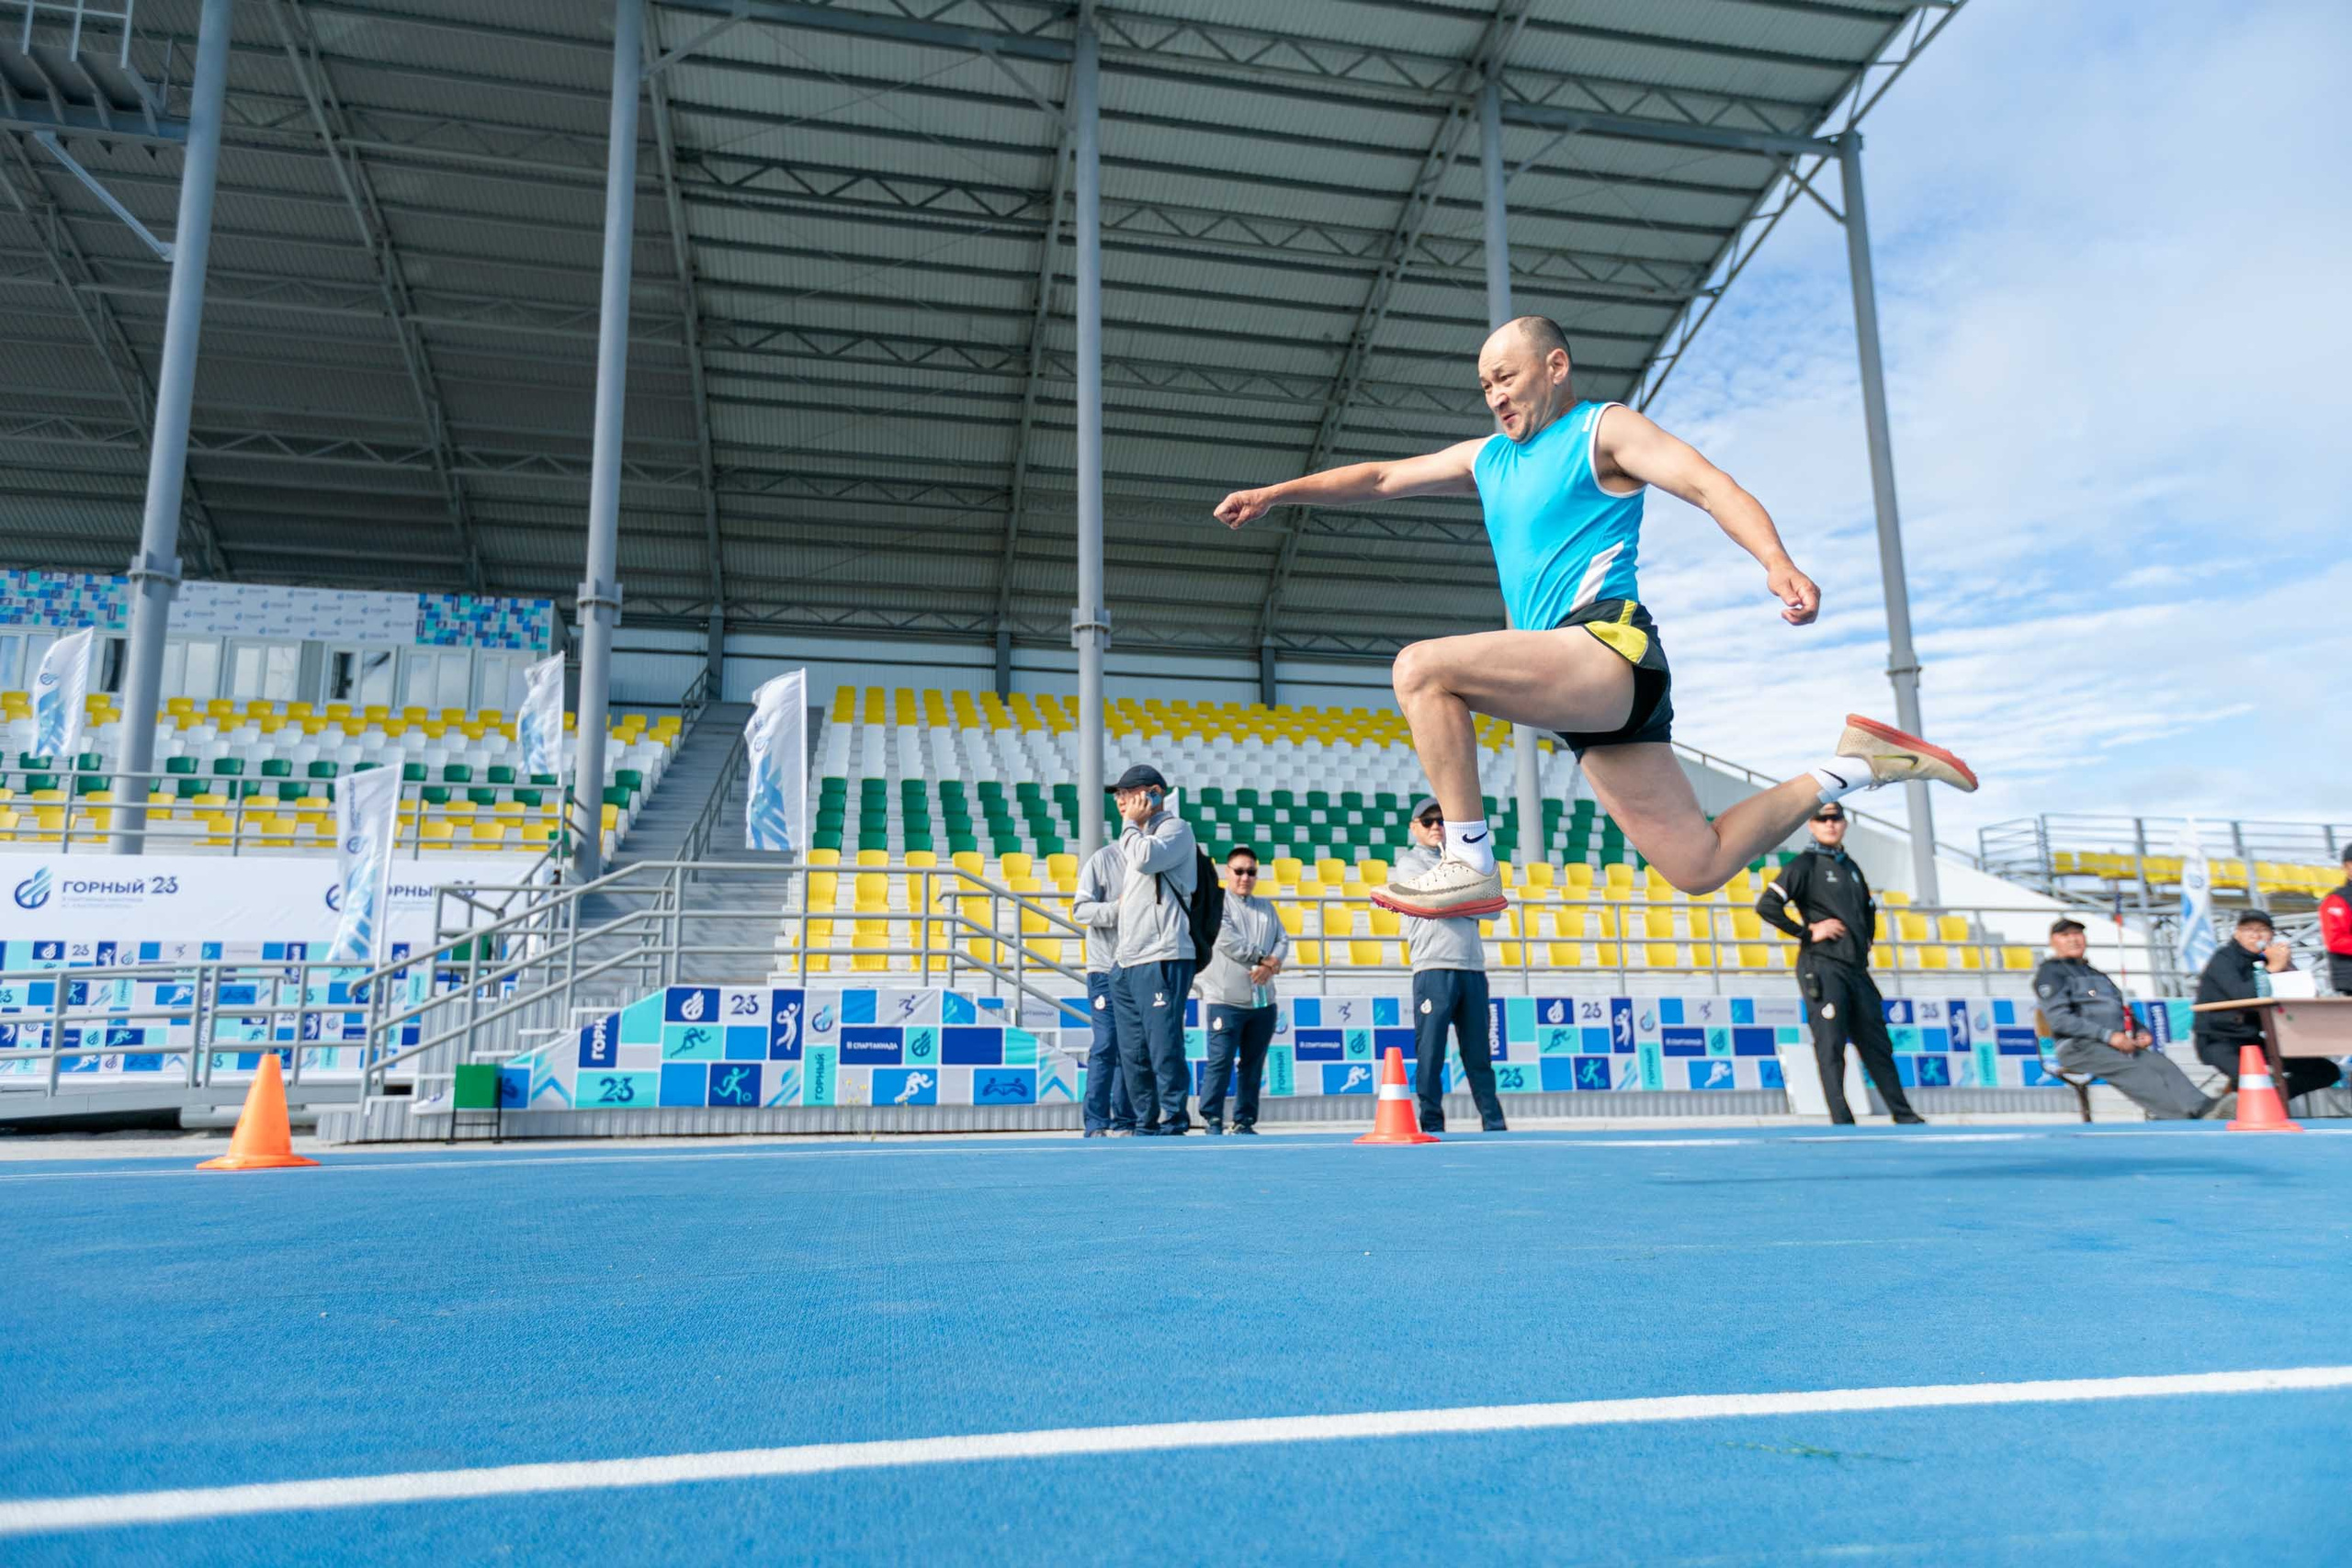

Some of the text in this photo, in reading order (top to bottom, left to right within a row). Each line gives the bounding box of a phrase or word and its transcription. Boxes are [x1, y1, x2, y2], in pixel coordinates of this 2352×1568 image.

[62, 878, 145, 894] ГОРНЫЙ
[72, 943, 90, 956] 23
[729, 993, 760, 1015] 23
[1581, 1002, 1602, 1019] 23
[591, 1015, 609, 1060] ГОРН
[1488, 1003, 1499, 1055] ГОРНЫЙ
[814, 1053, 826, 1100] ГОРНЫЙ
[1499, 1067, 1525, 1089] 23
[599, 1076, 635, 1101] 23
